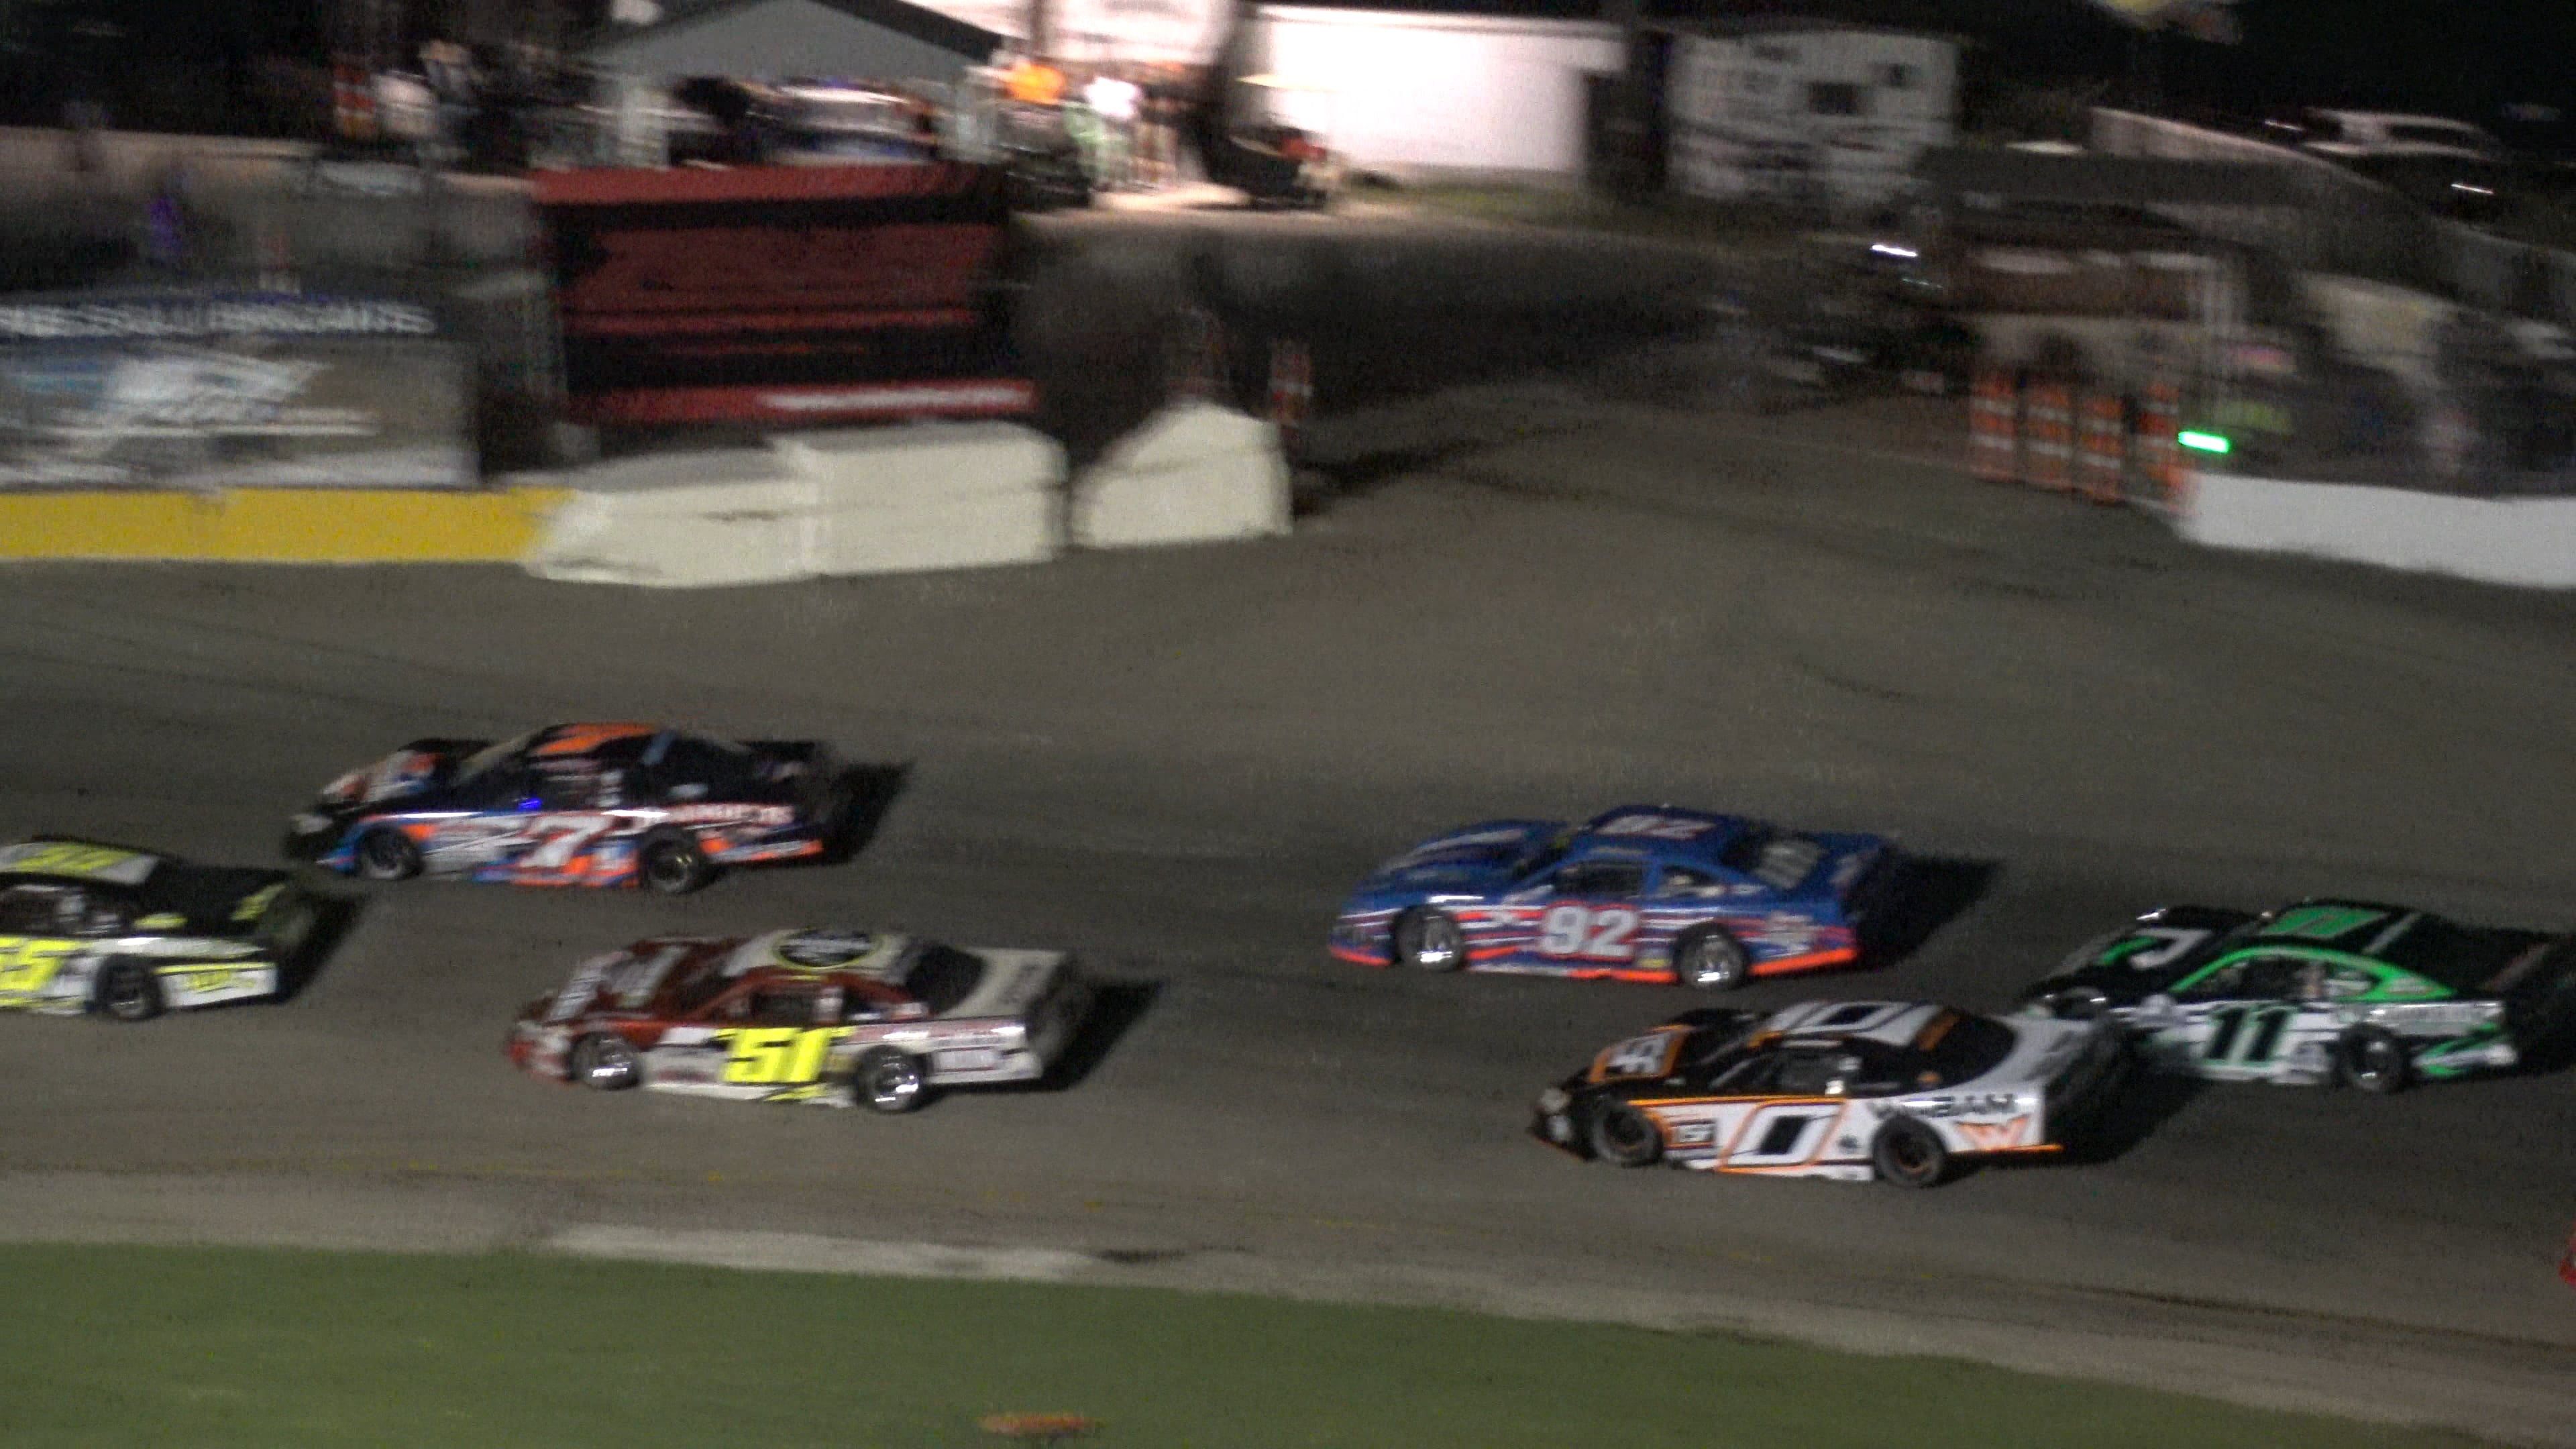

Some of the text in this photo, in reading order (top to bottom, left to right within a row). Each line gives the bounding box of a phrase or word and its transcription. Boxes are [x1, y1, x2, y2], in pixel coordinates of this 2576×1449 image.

[1541, 902, 1637, 961] 92
[716, 1027, 835, 1083] 51
[2202, 1006, 2290, 1060] 11
